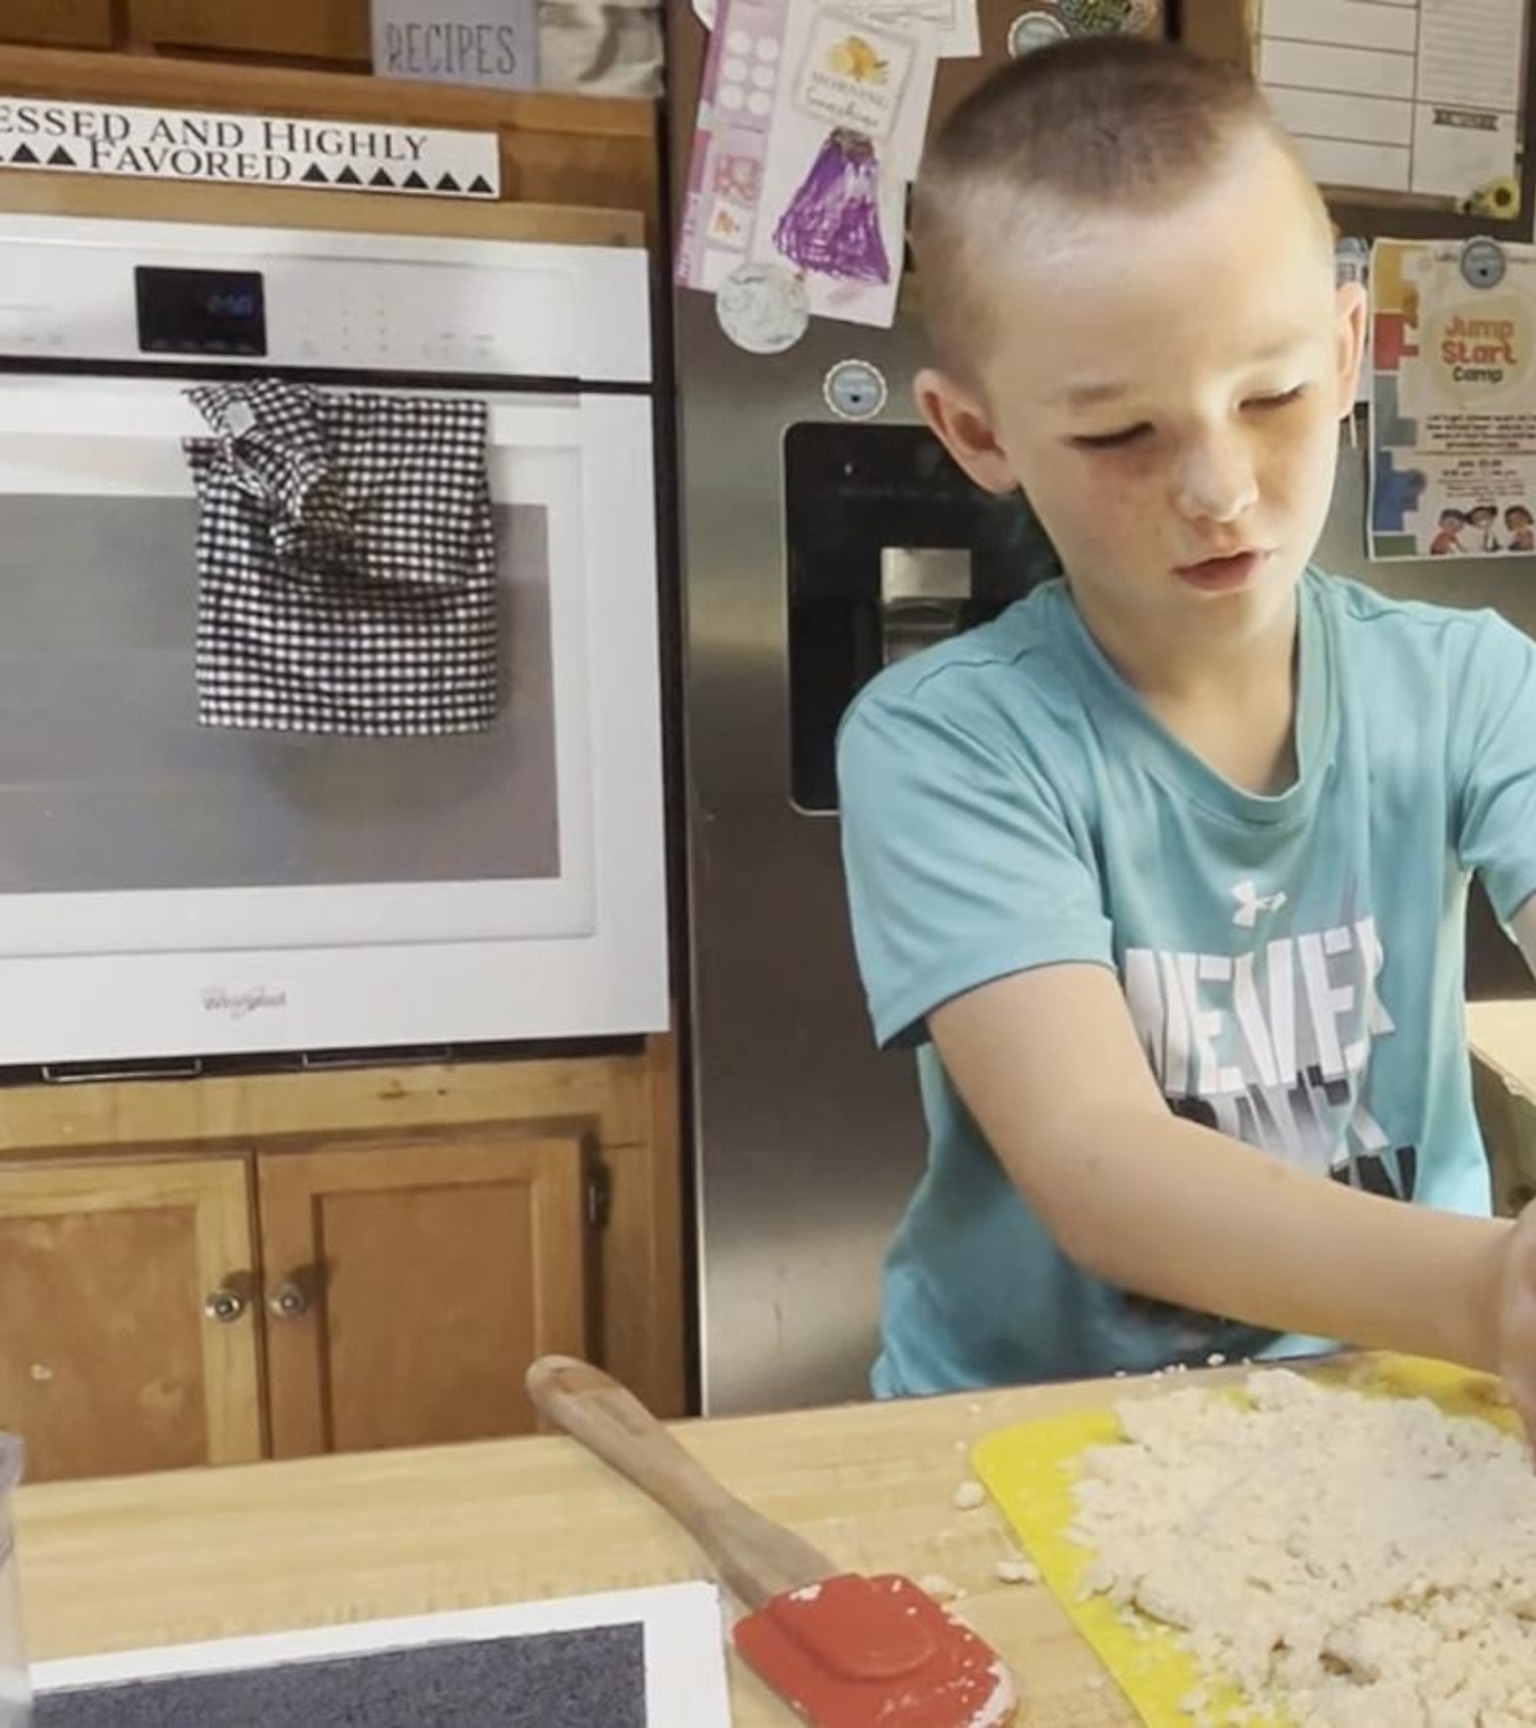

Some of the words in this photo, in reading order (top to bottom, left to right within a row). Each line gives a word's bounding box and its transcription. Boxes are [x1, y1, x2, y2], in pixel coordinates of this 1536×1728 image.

[386, 22, 516, 75] RECIPES
[150, 117, 244, 149] AND
[1444, 315, 1514, 341] Jump
[1442, 340, 1518, 365] Start
[1453, 366, 1503, 384] Camp
